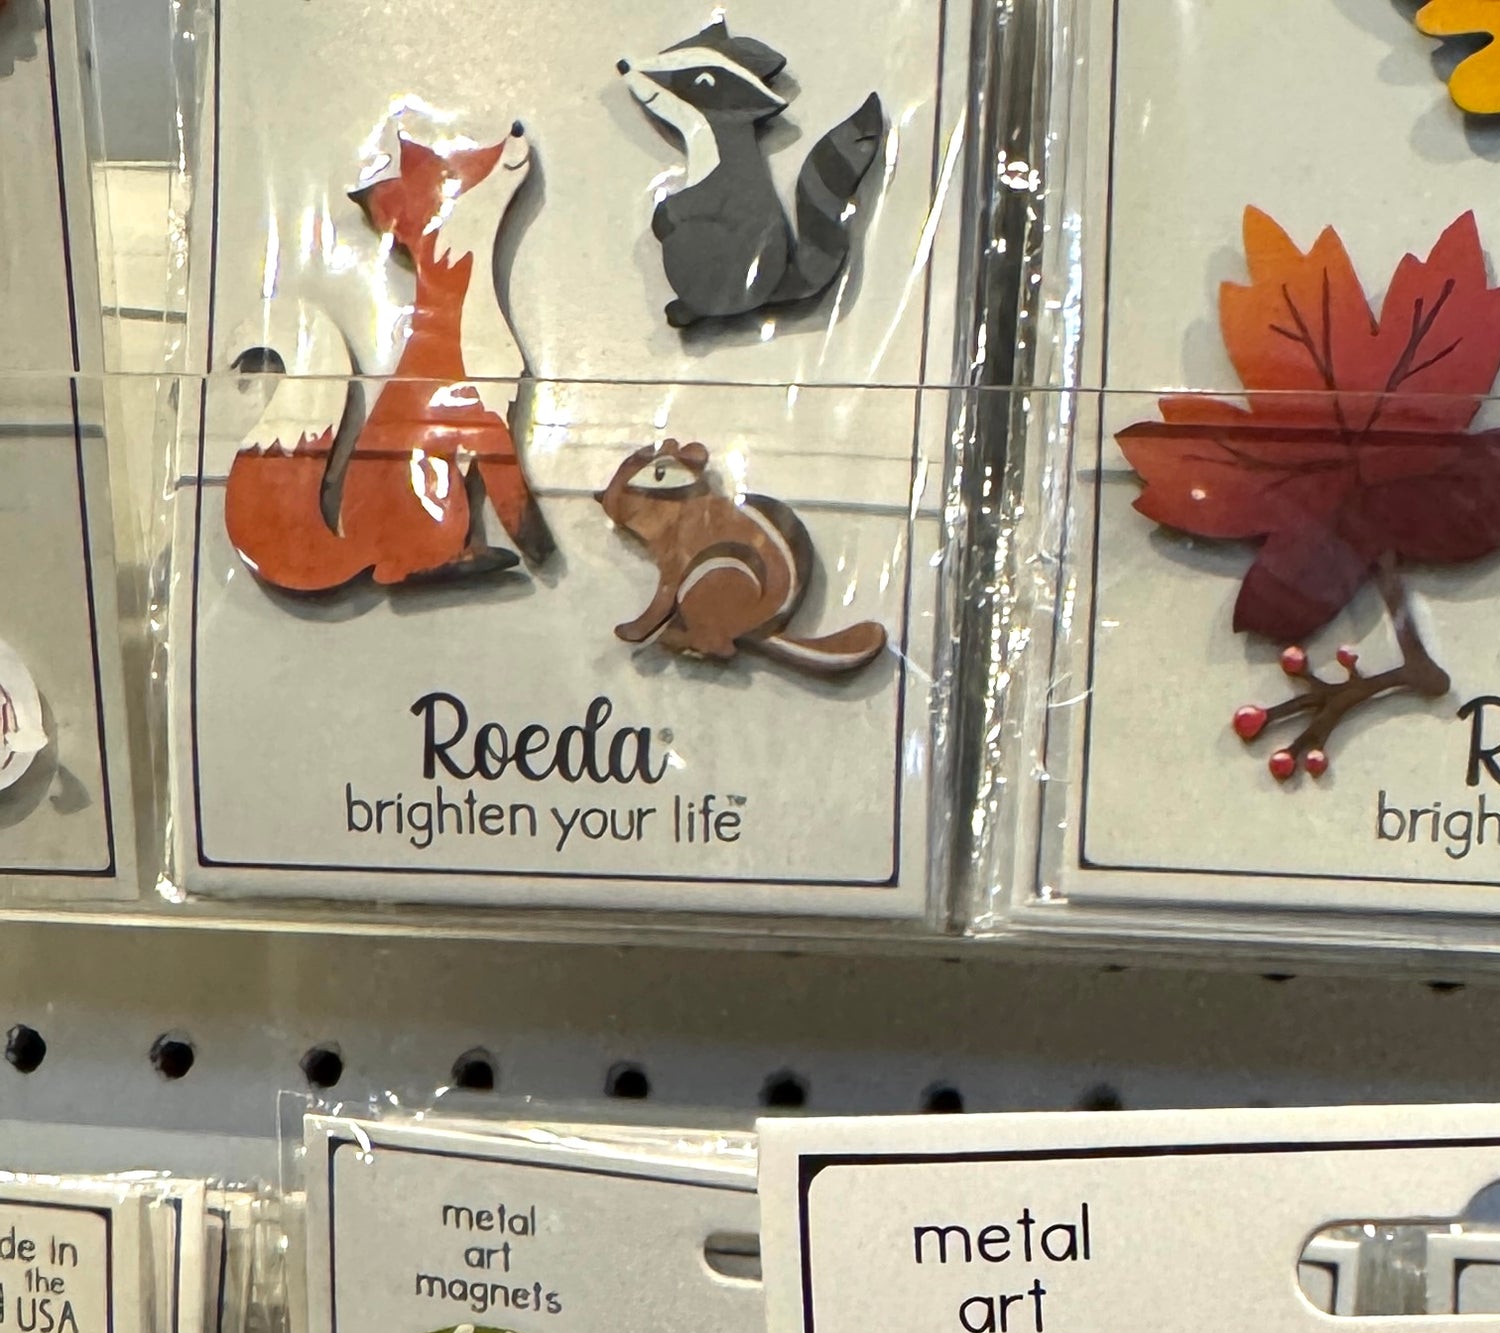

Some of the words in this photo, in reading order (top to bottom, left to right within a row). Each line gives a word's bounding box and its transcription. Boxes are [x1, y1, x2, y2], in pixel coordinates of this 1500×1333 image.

[346, 783, 536, 849] brighten
[551, 807, 656, 852] your
[442, 1203, 535, 1236] metal
[913, 1202, 1091, 1264] metal
[51, 1235, 78, 1268] in
[464, 1241, 512, 1272] art
[25, 1267, 65, 1295] the
[416, 1273, 562, 1314] magnets
[959, 1279, 1046, 1333] art
